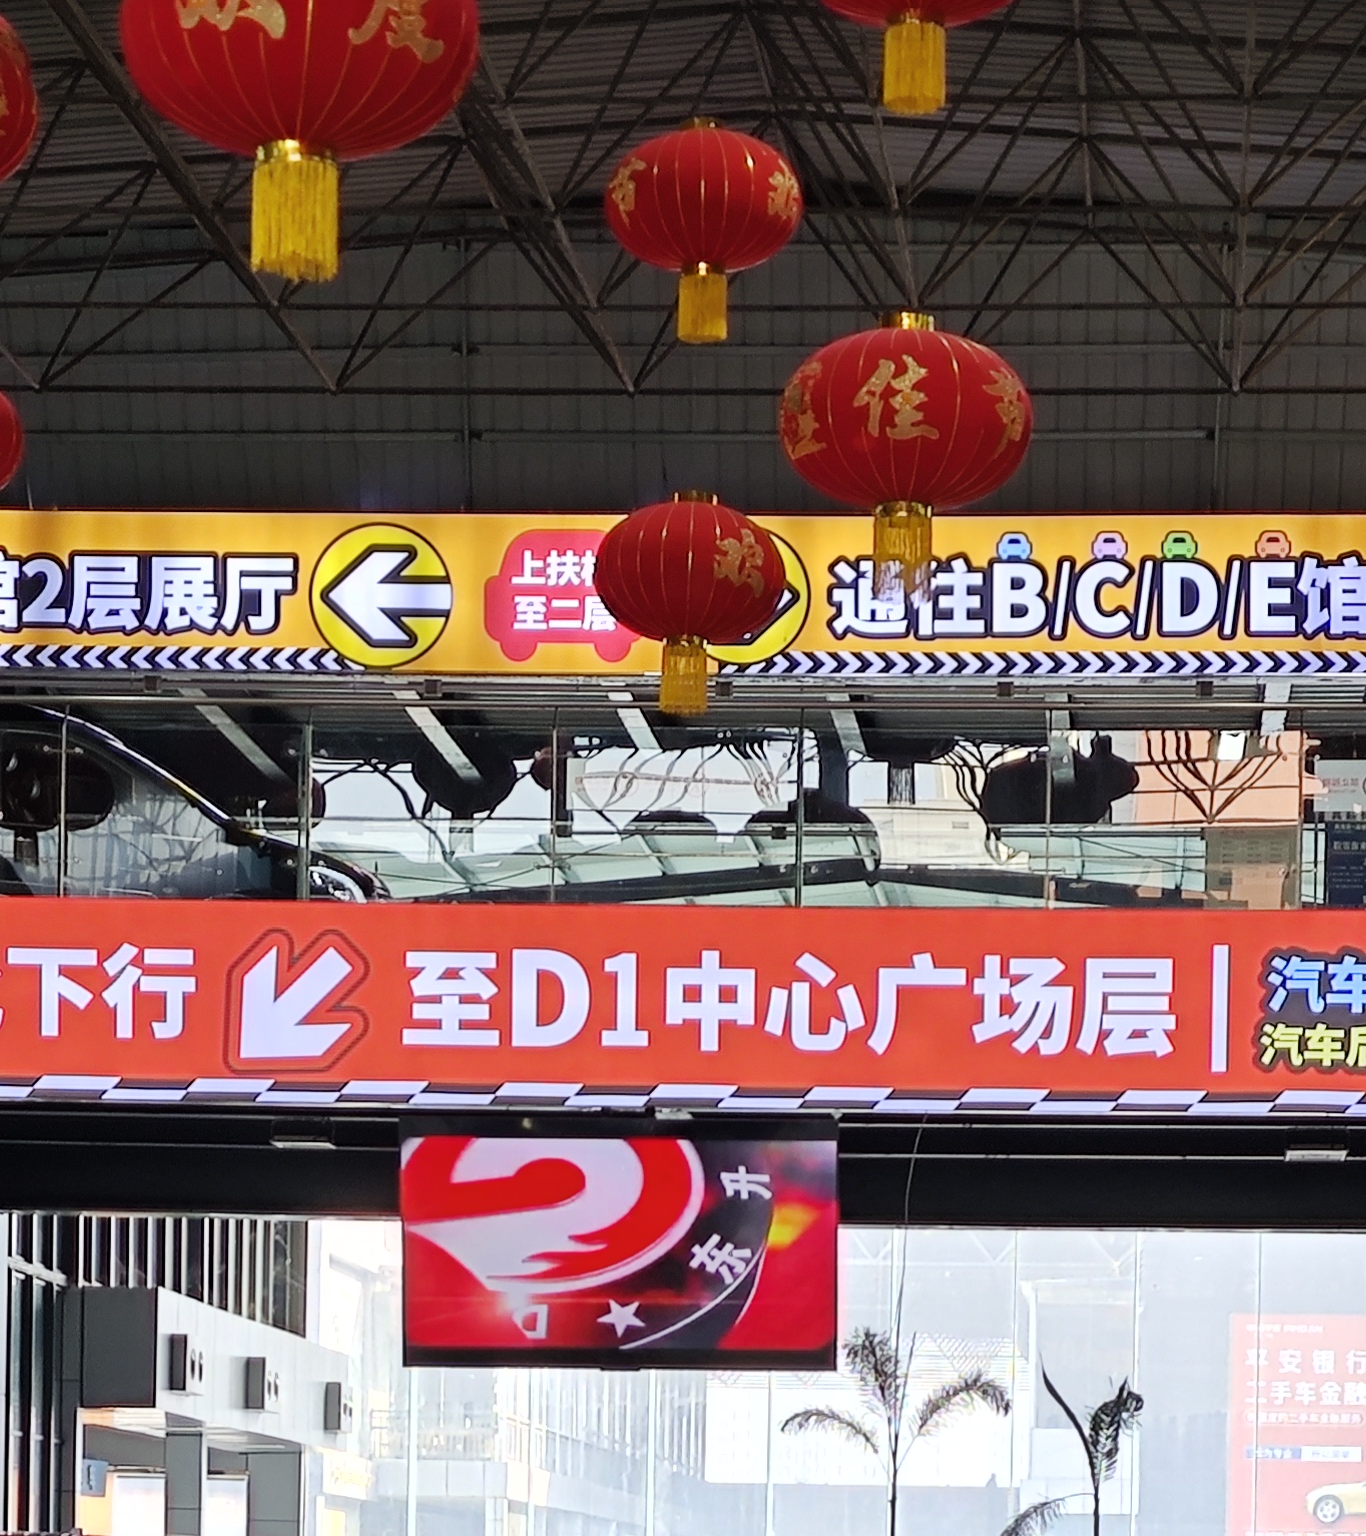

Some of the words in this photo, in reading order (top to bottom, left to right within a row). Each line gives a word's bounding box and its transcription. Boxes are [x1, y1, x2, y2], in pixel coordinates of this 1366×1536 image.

[512, 595, 618, 632] 至二层
[401, 948, 1177, 1058] 至D1中心广场层
